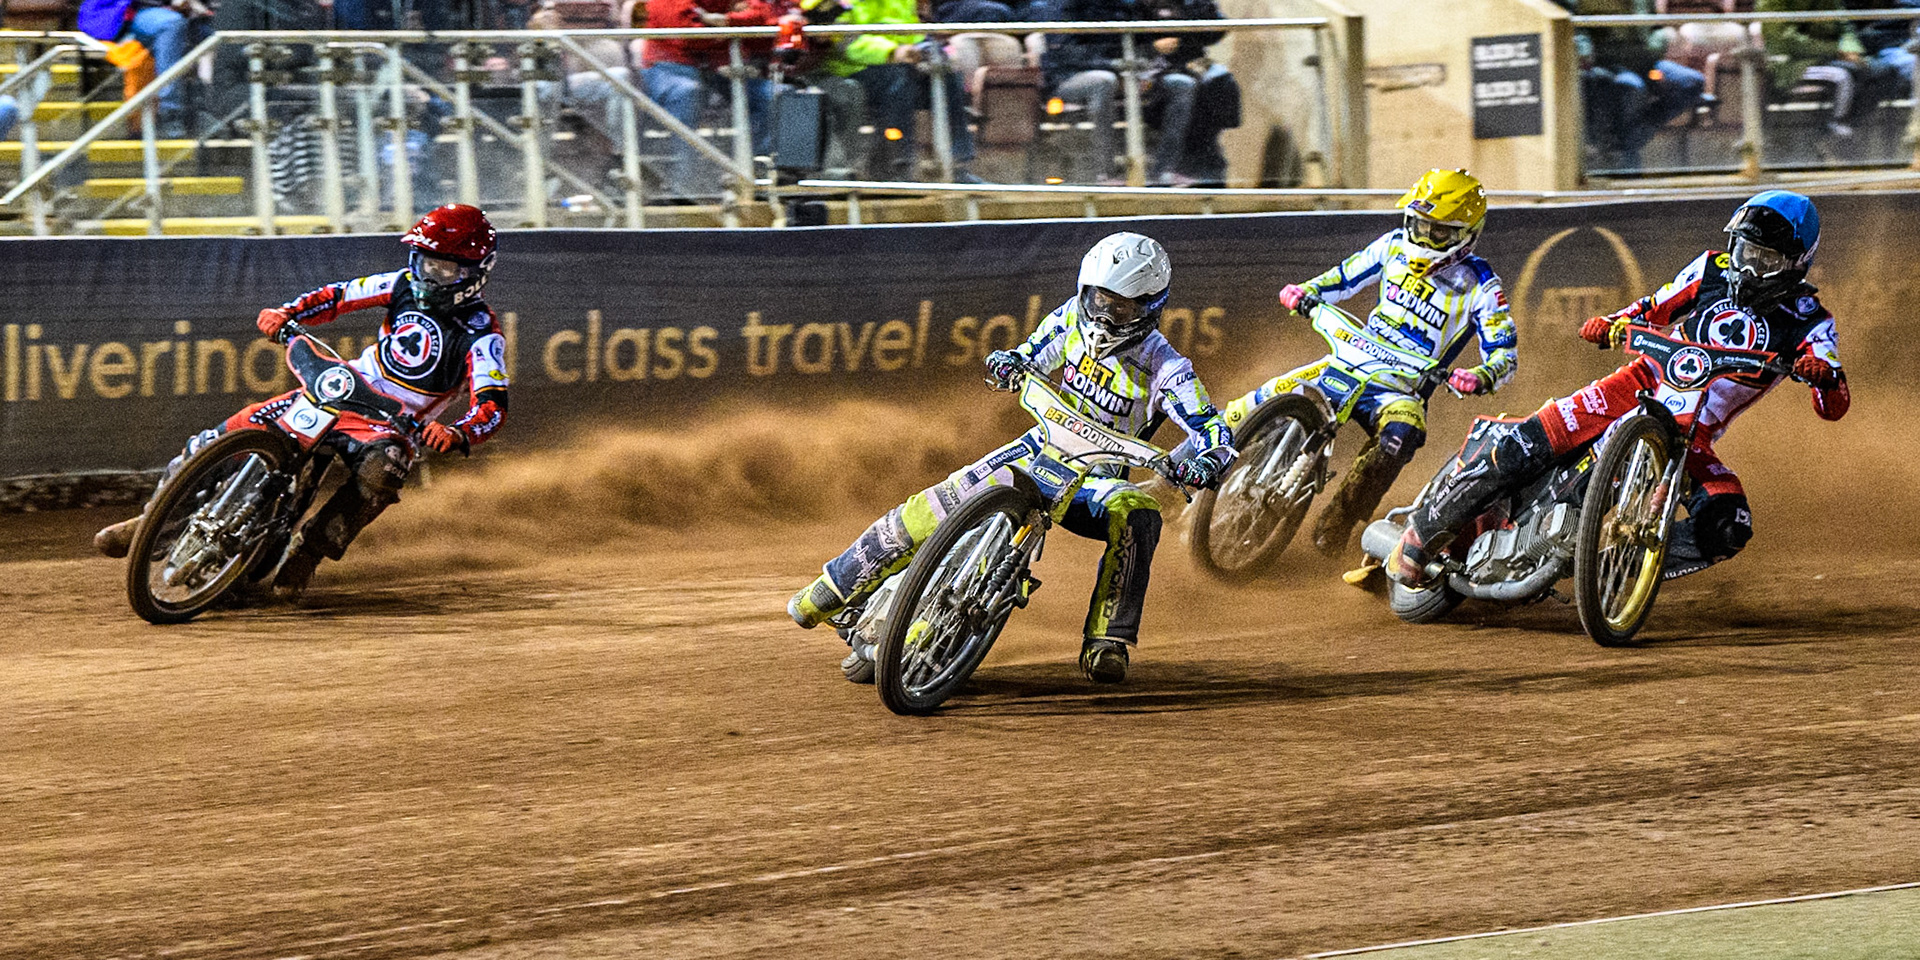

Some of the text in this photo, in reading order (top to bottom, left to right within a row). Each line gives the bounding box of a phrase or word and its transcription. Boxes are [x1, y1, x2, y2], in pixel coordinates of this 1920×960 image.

[1386, 281, 1446, 328] OODWIN
[1401, 275, 1435, 301] BET
[543, 309, 719, 384] class
[742, 300, 934, 376] travel
[1755, 322, 1766, 345] ACES
[1065, 362, 1132, 417] OODWIN
[1078, 354, 1113, 387] BET
[1045, 406, 1125, 453] BETGOODWIN
[974, 465, 989, 478] Ice
[988, 445, 1027, 468] Machines
